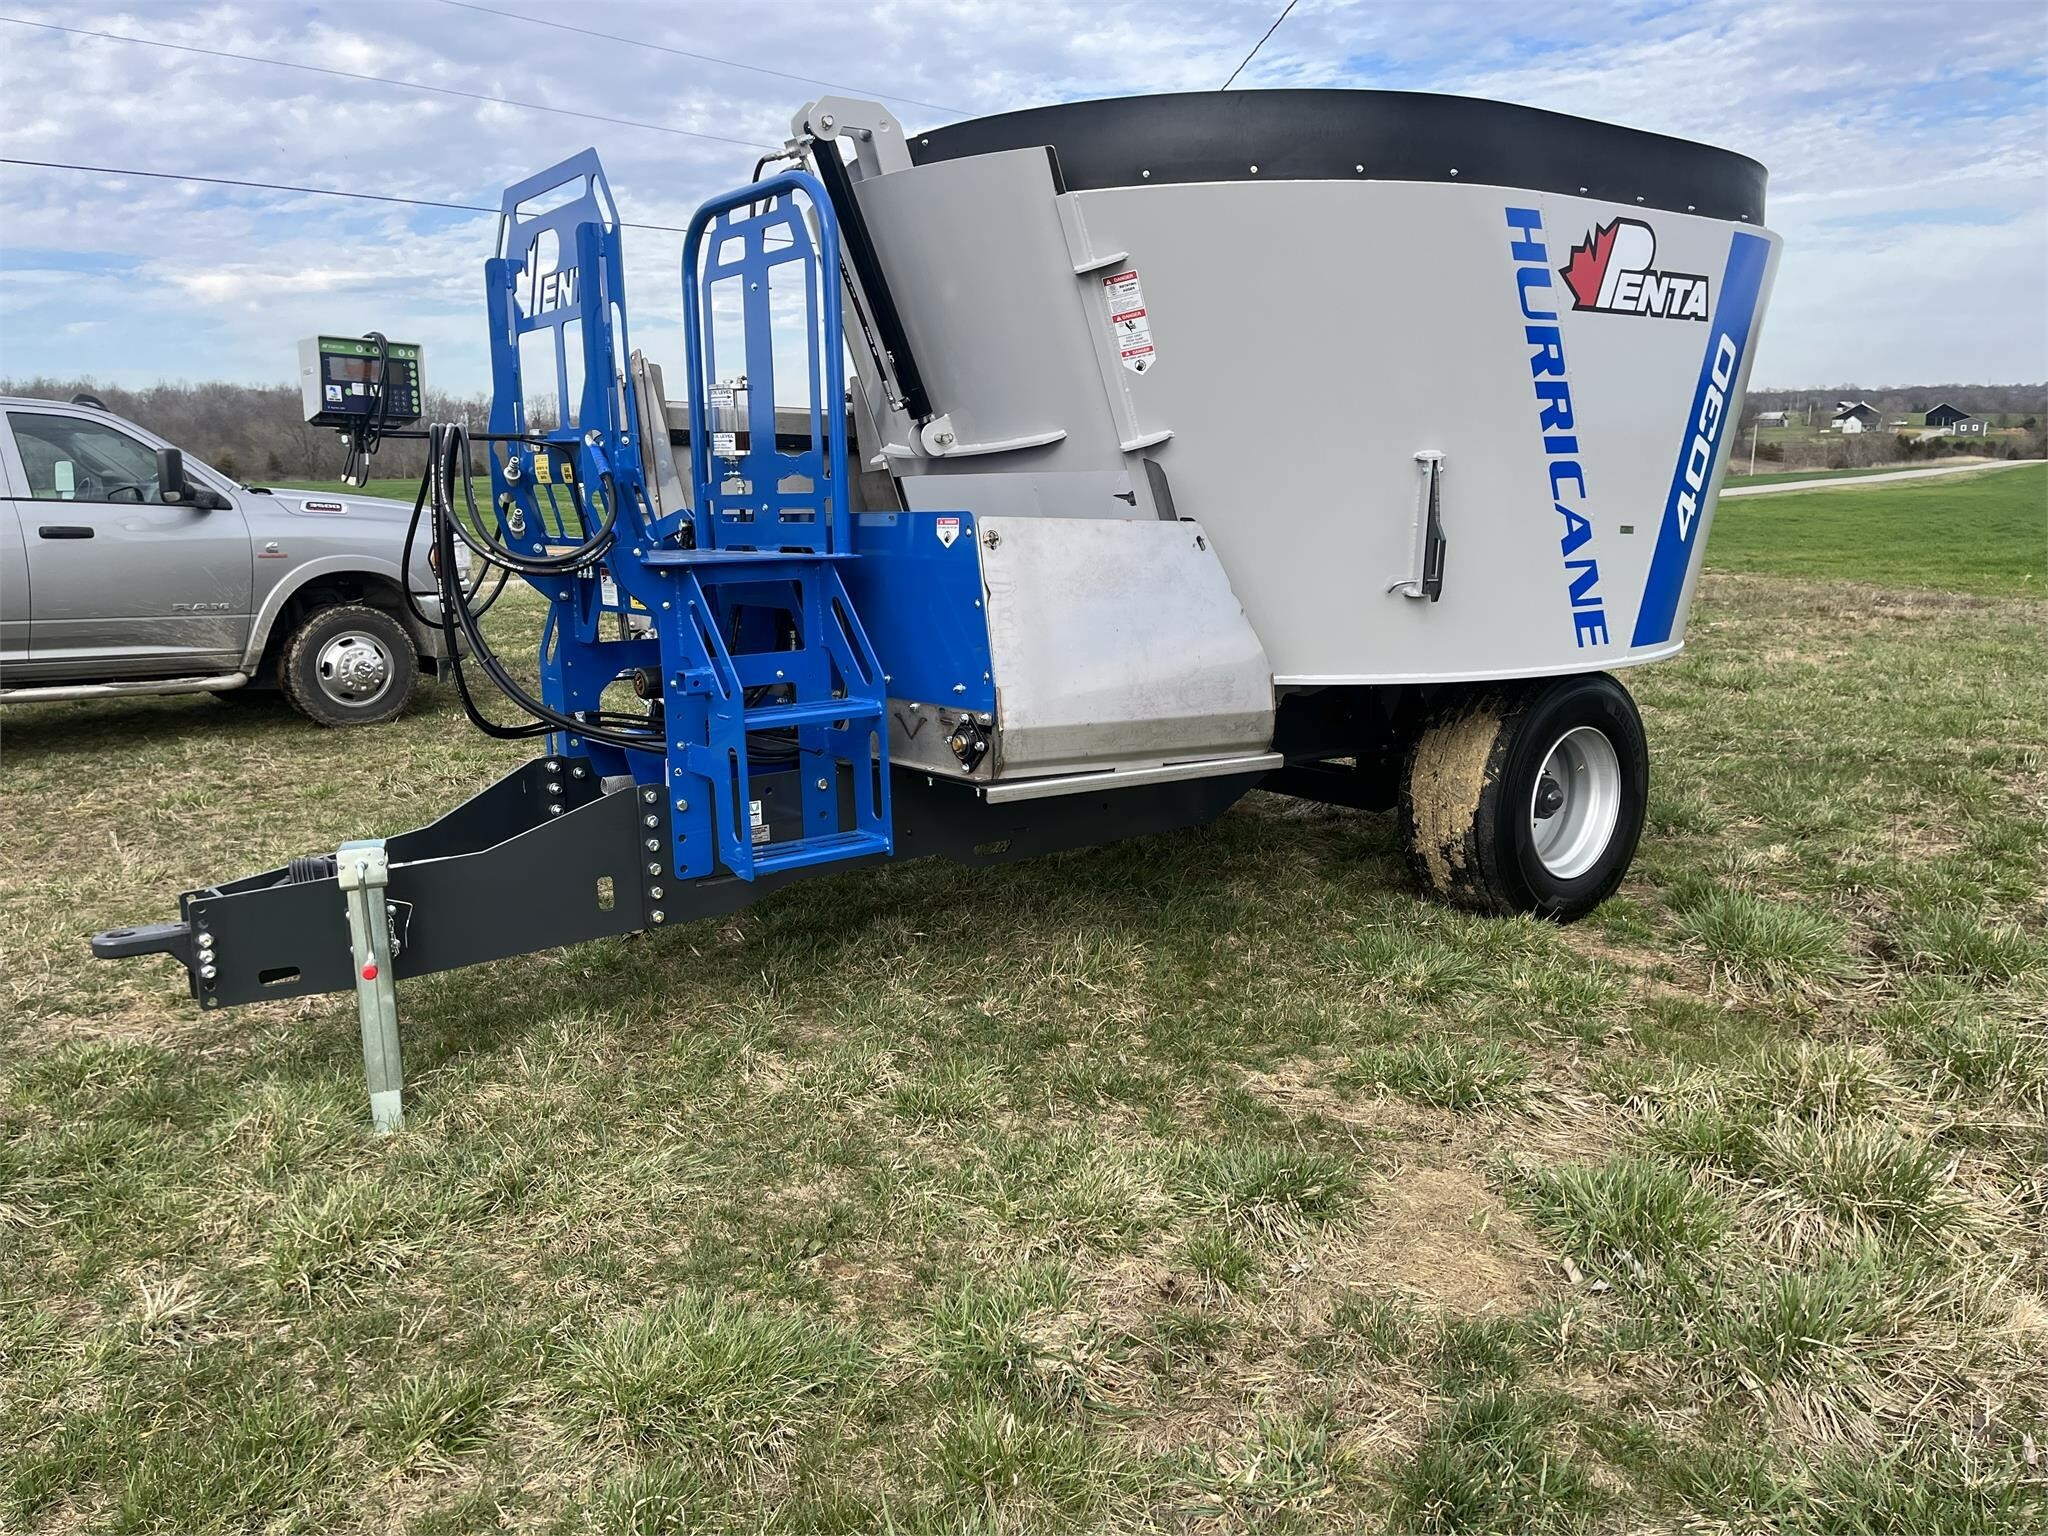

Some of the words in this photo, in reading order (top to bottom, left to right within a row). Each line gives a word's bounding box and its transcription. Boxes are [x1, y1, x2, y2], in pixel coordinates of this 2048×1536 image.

[1595, 222, 1708, 319] PENTA
[1113, 272, 1135, 283] DANGER
[1121, 310, 1142, 320] DANGER
[1132, 347, 1151, 355] DANGER
[1505, 207, 1609, 648] HURRICANE
[1676, 332, 1737, 542] 4030
[172, 602, 230, 611] RAM
